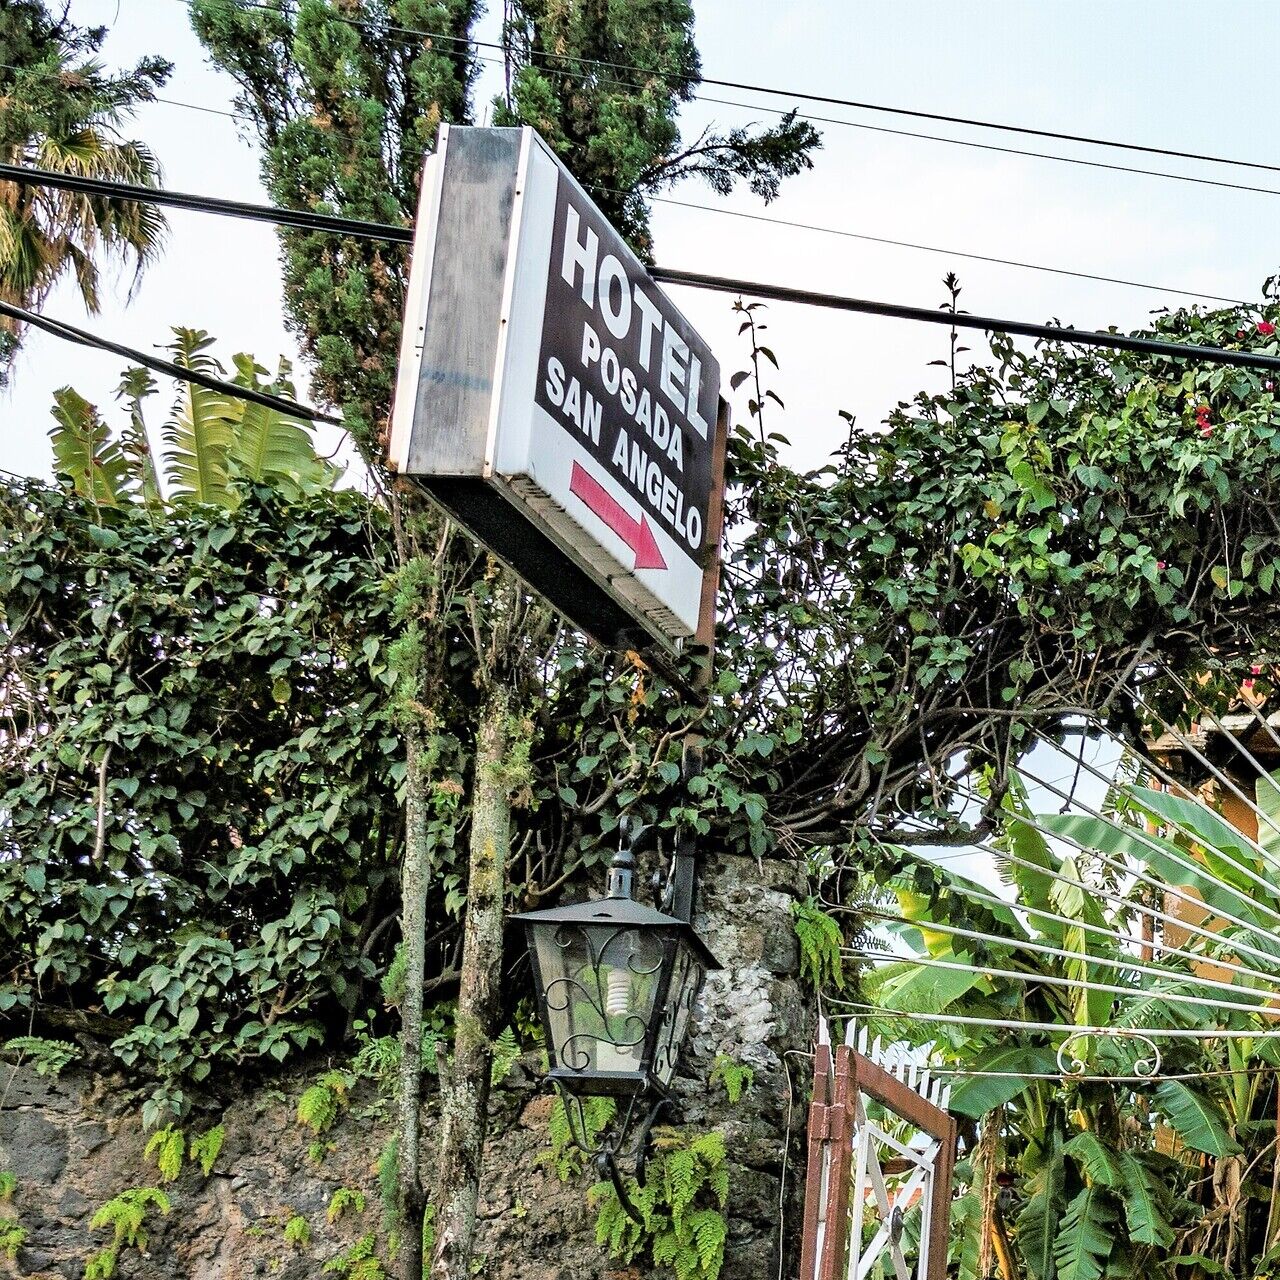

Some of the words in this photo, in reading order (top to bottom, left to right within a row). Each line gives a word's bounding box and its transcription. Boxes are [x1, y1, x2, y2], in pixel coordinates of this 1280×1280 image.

[561, 202, 708, 442] HOTEL
[581, 321, 684, 474] POSADA
[545, 355, 603, 448] SAN
[611, 438, 703, 551] ANGELO
